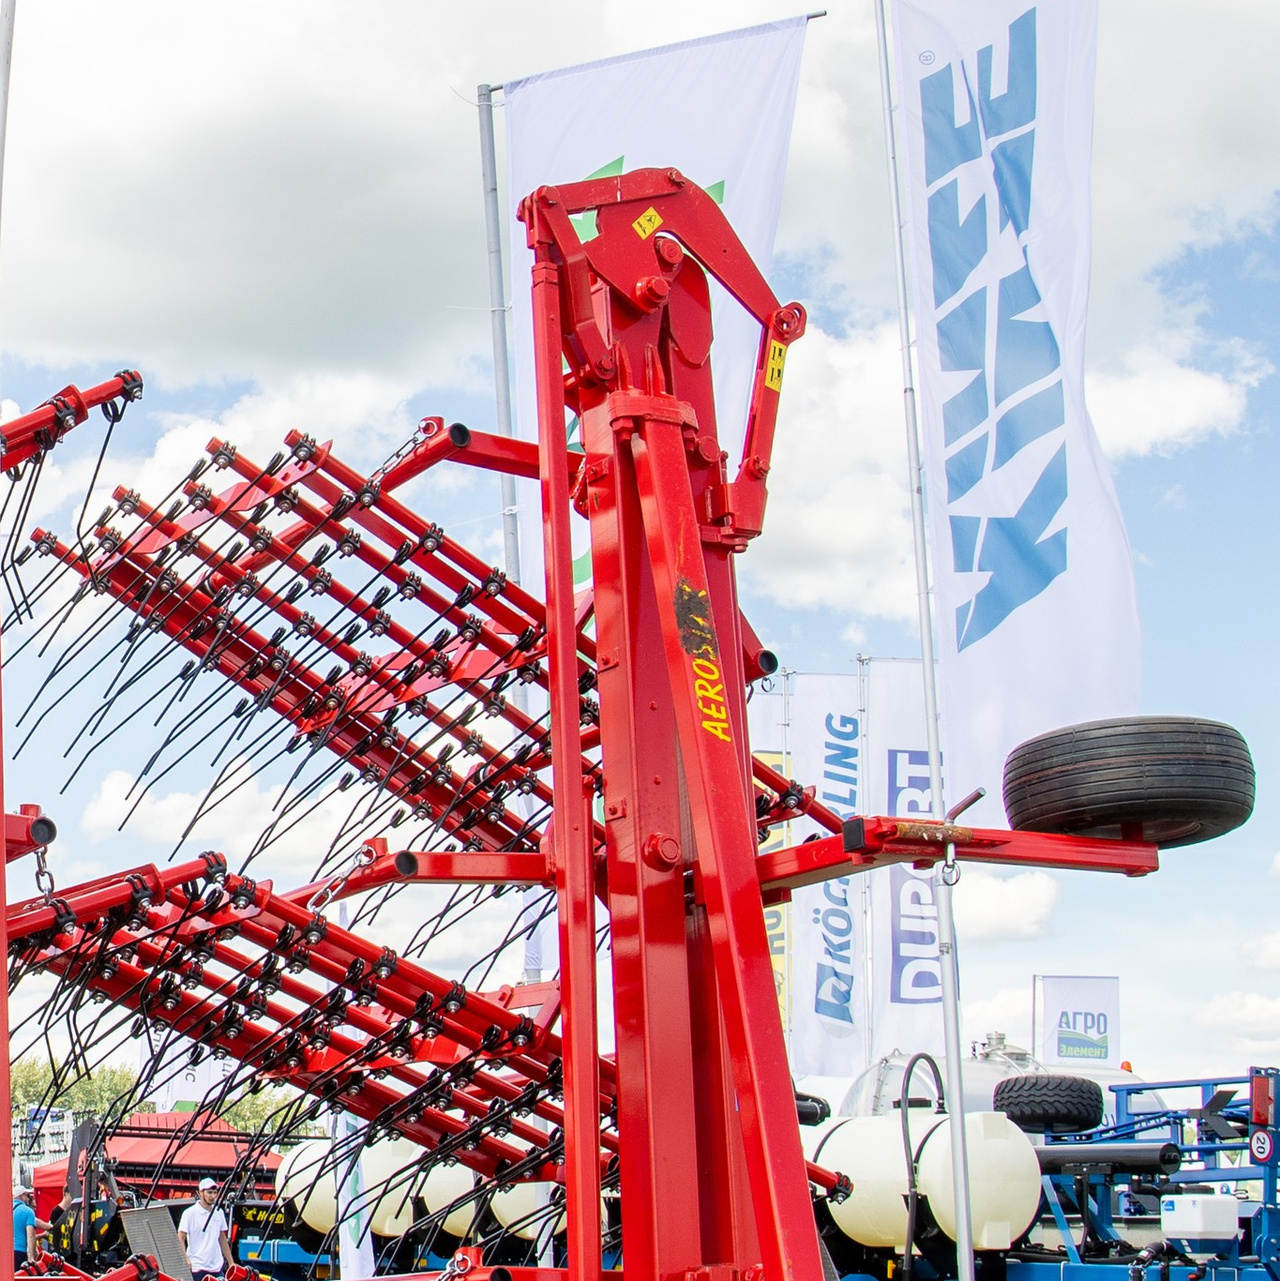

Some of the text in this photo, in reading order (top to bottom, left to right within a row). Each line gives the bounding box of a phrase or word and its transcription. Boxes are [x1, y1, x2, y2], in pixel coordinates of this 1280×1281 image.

[1058, 1011, 1108, 1035] АГРО
[1060, 1044, 1106, 1058] Элемент
[1255, 1136, 1266, 1155] 20
